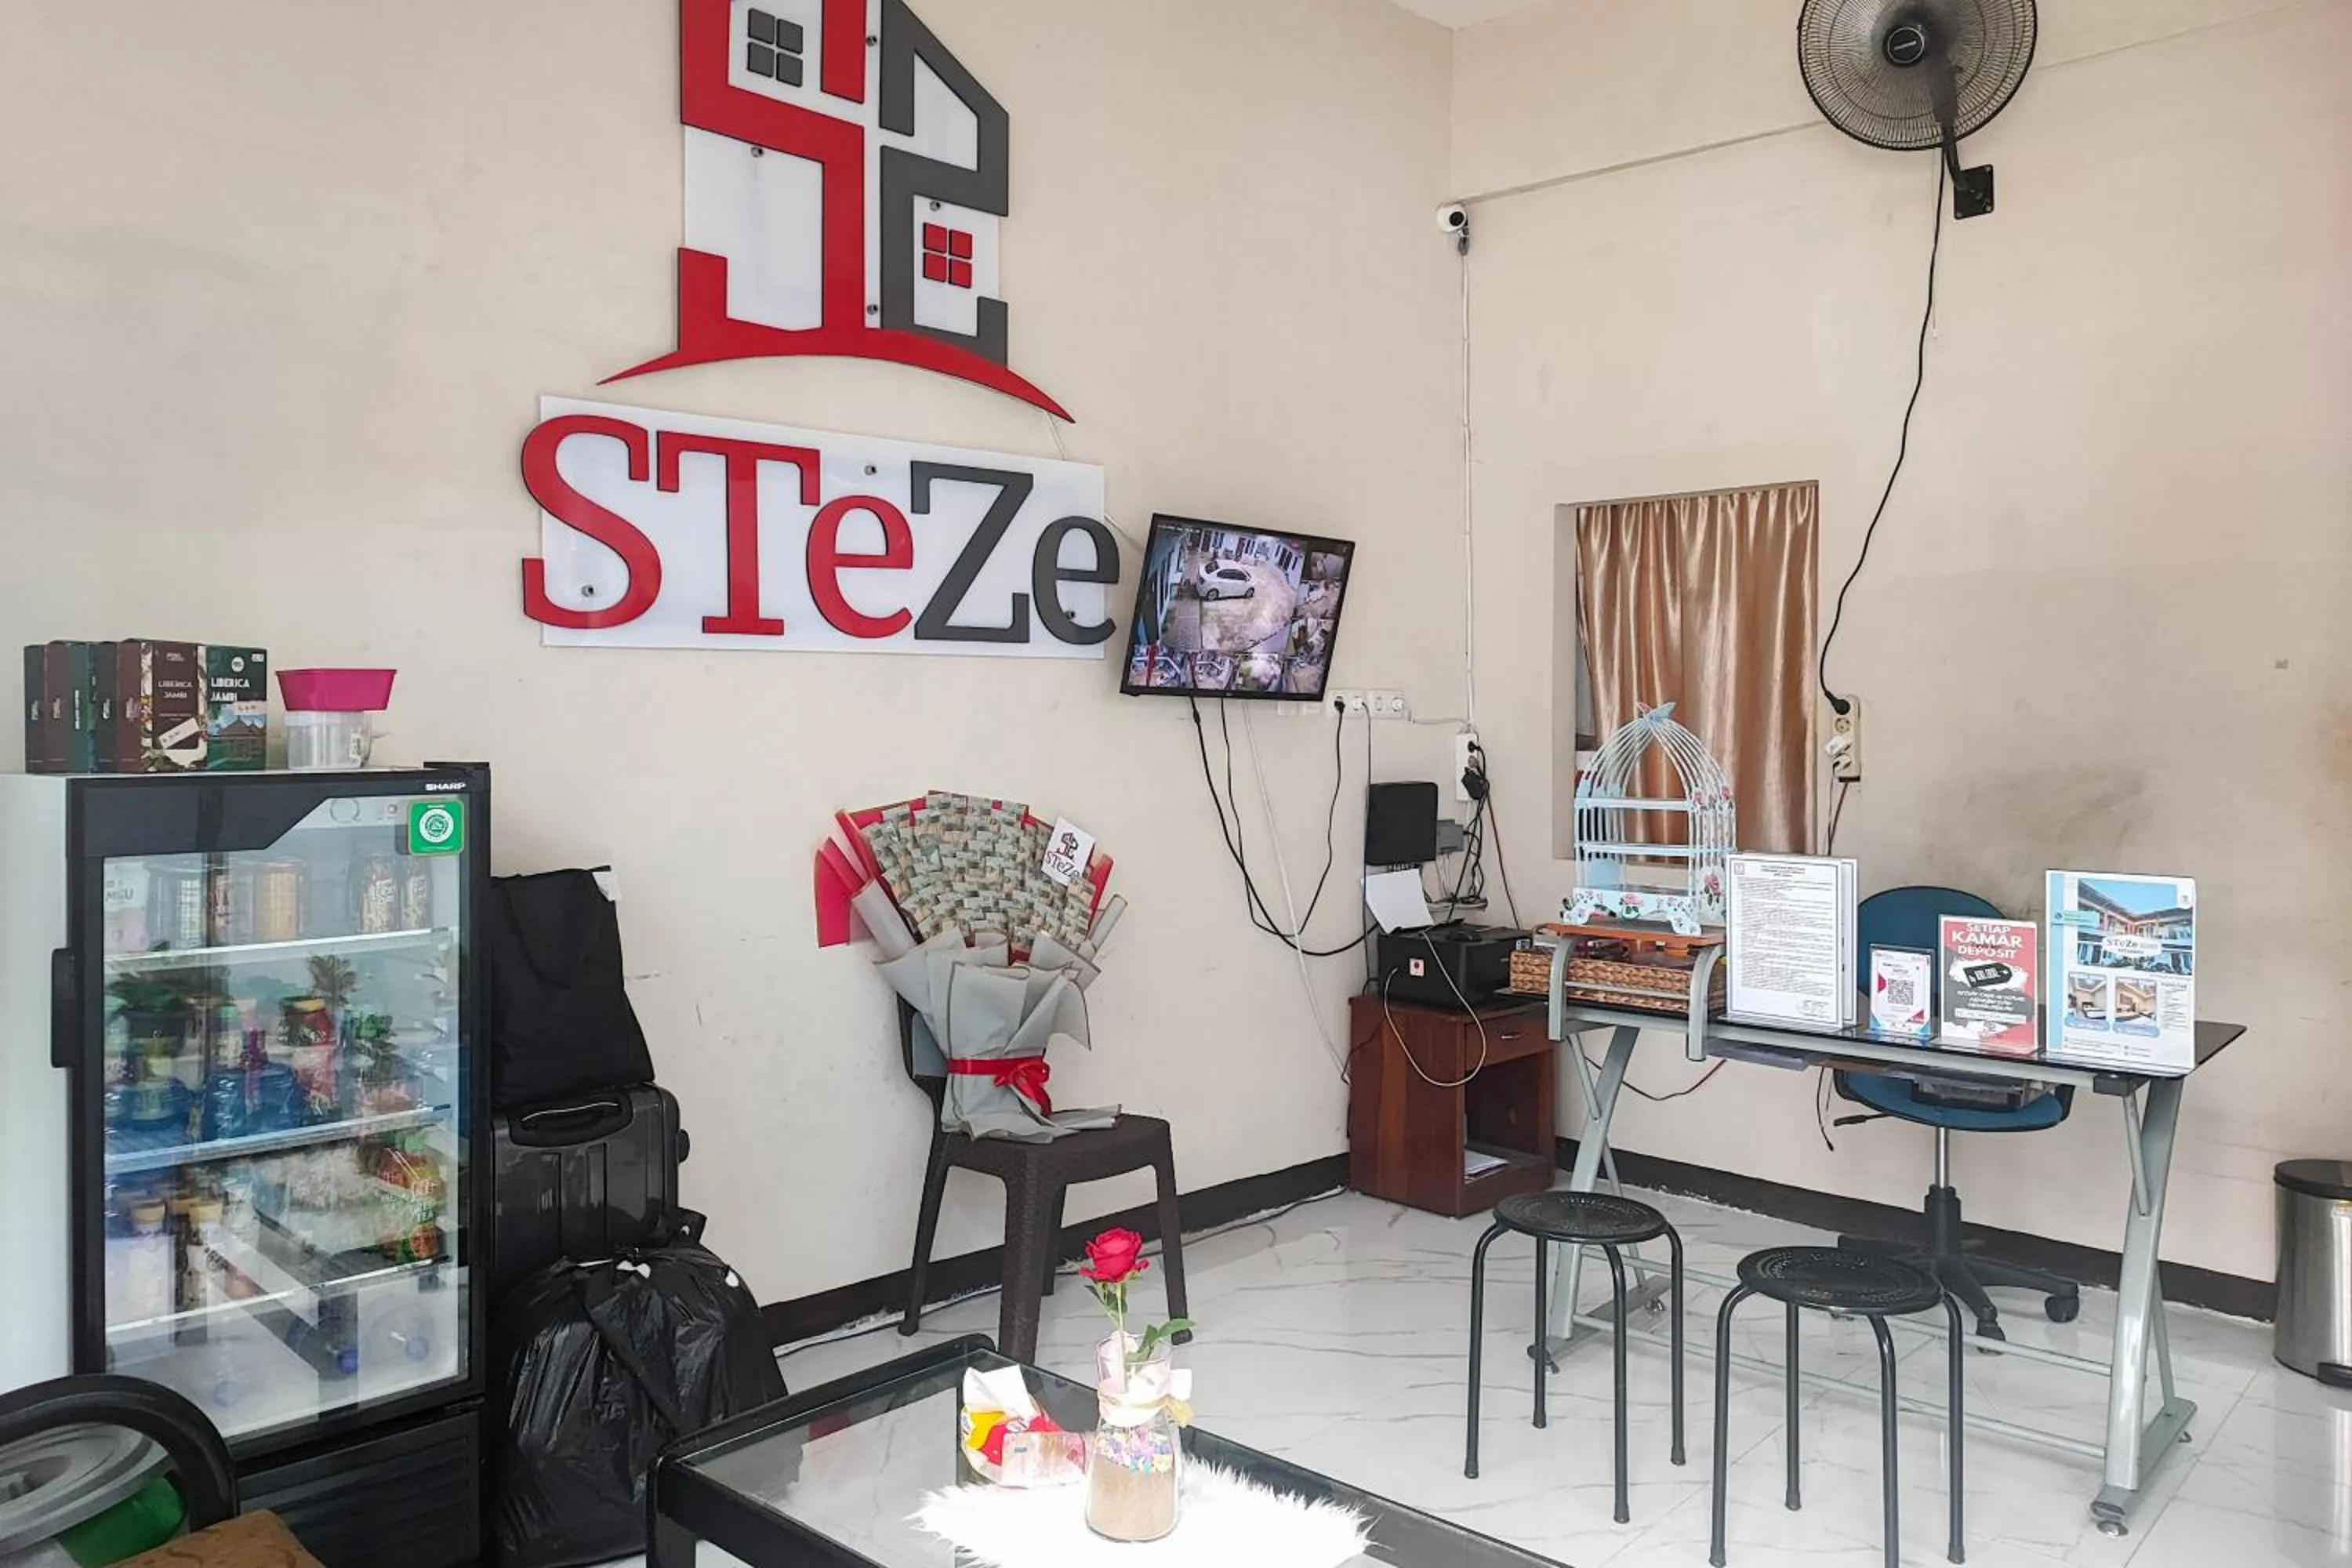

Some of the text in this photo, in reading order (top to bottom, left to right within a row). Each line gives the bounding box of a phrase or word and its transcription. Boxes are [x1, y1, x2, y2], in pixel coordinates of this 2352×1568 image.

[521, 413, 1120, 645] STeZe
[158, 680, 193, 688] LIBERICA
[211, 677, 250, 688] LIBERICA
[210, 692, 238, 702] JAMBI
[425, 782, 466, 791] SHARP
[1966, 923, 2011, 934] SETIAP
[1951, 930, 2023, 949] KAMAR
[1958, 945, 2017, 959] DEPOSIT
